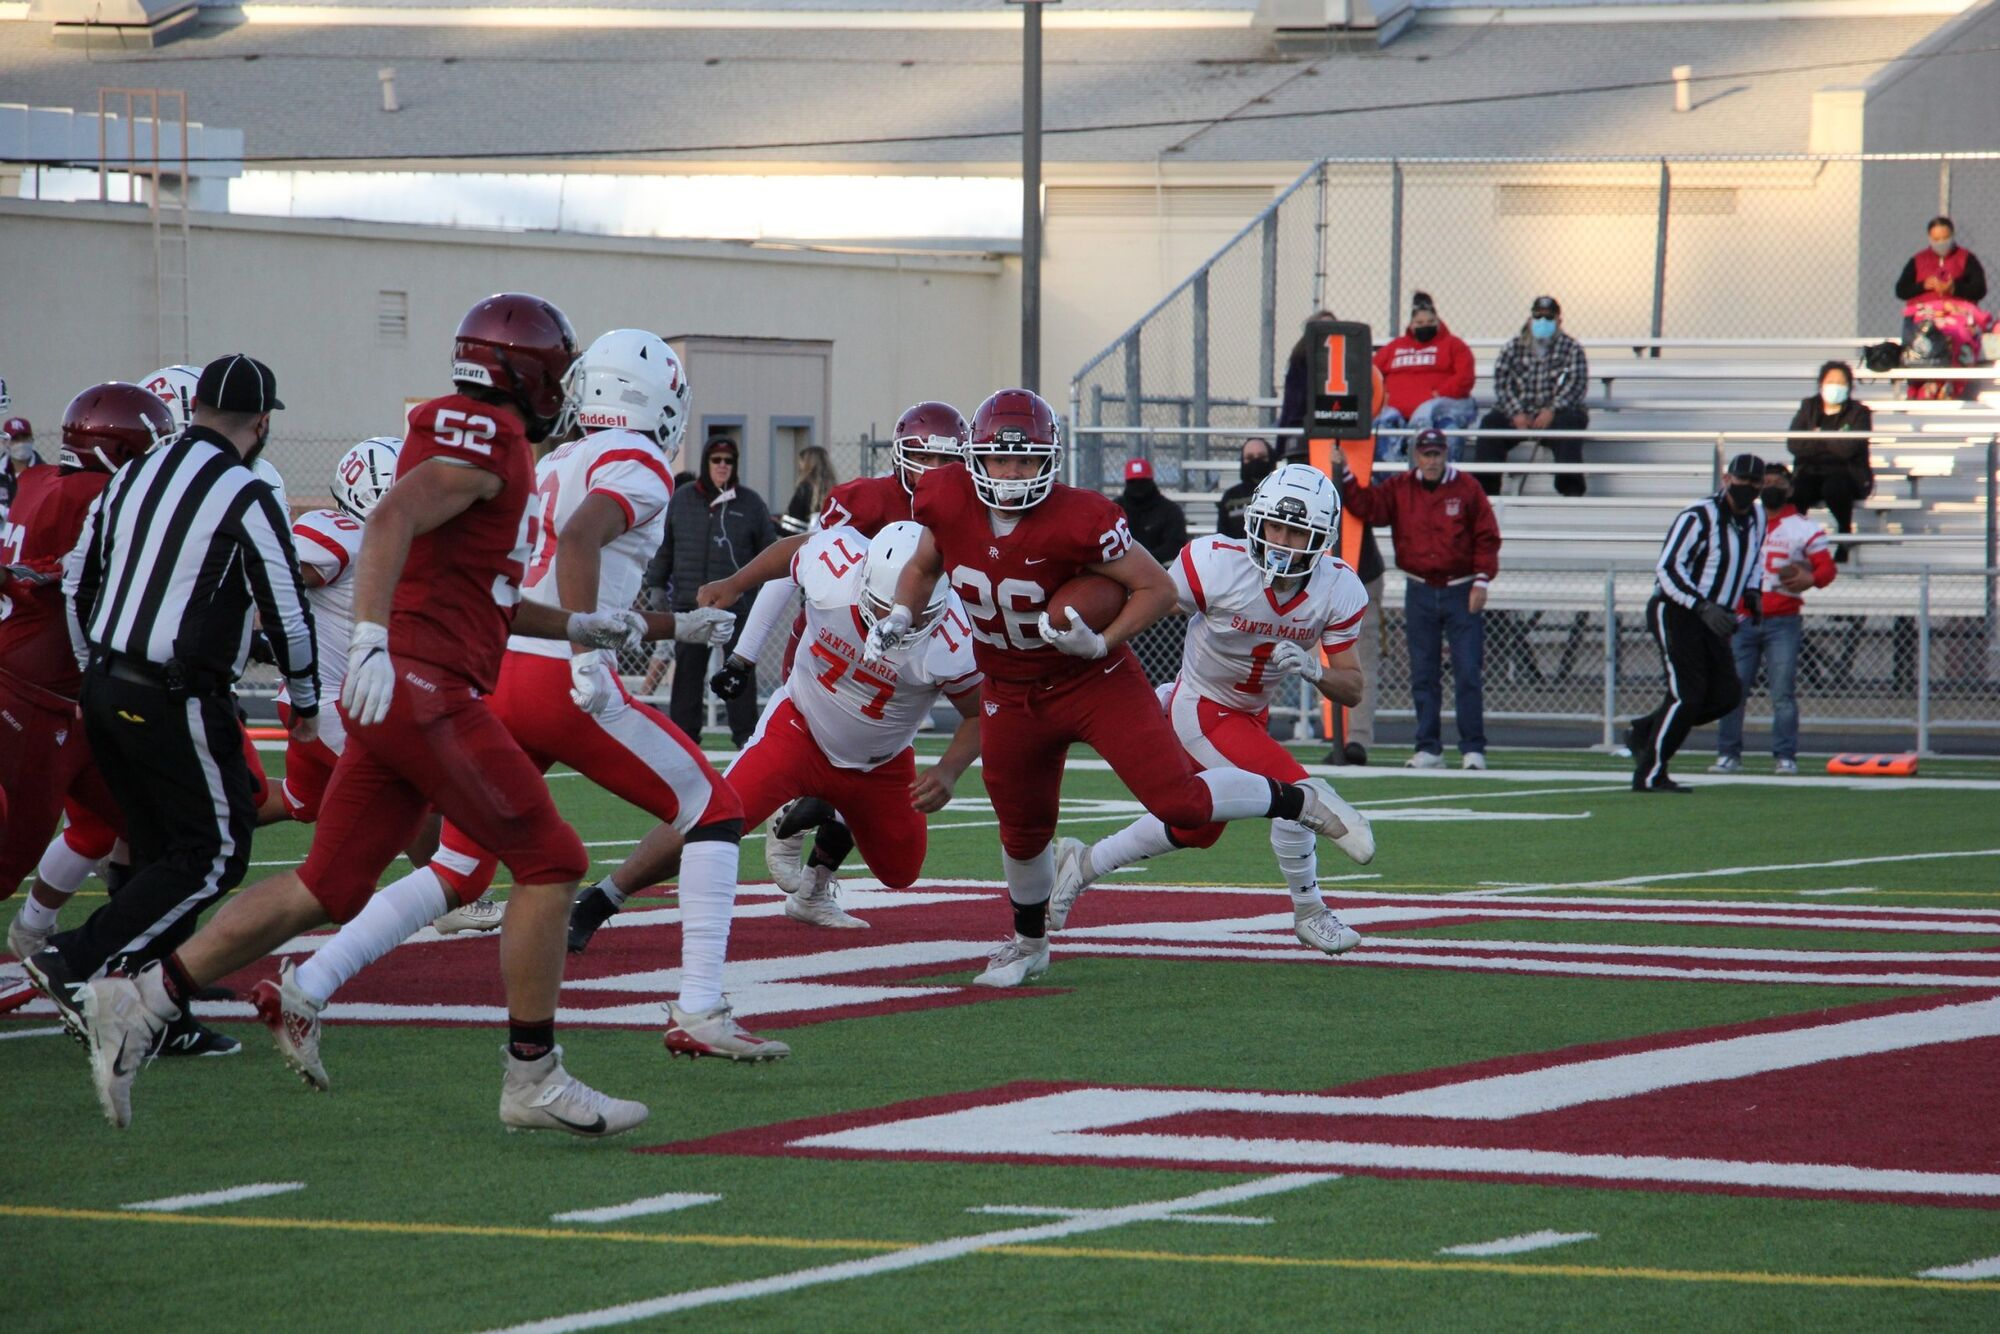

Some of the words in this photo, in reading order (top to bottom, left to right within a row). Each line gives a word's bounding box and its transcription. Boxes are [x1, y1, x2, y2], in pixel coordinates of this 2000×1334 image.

[1324, 335, 1349, 396] 1
[434, 408, 497, 456] 52
[580, 413, 628, 428] Riddell
[340, 451, 365, 486] 30
[819, 538, 863, 579] 77
[1098, 517, 1133, 563] 26
[951, 564, 1051, 650] 26
[1231, 615, 1274, 636] SANTA
[1275, 625, 1316, 640] MARIA
[818, 627, 857, 661] SANTA
[931, 608, 972, 653] 77
[809, 640, 896, 720] 77
[1234, 642, 1279, 694] 1
